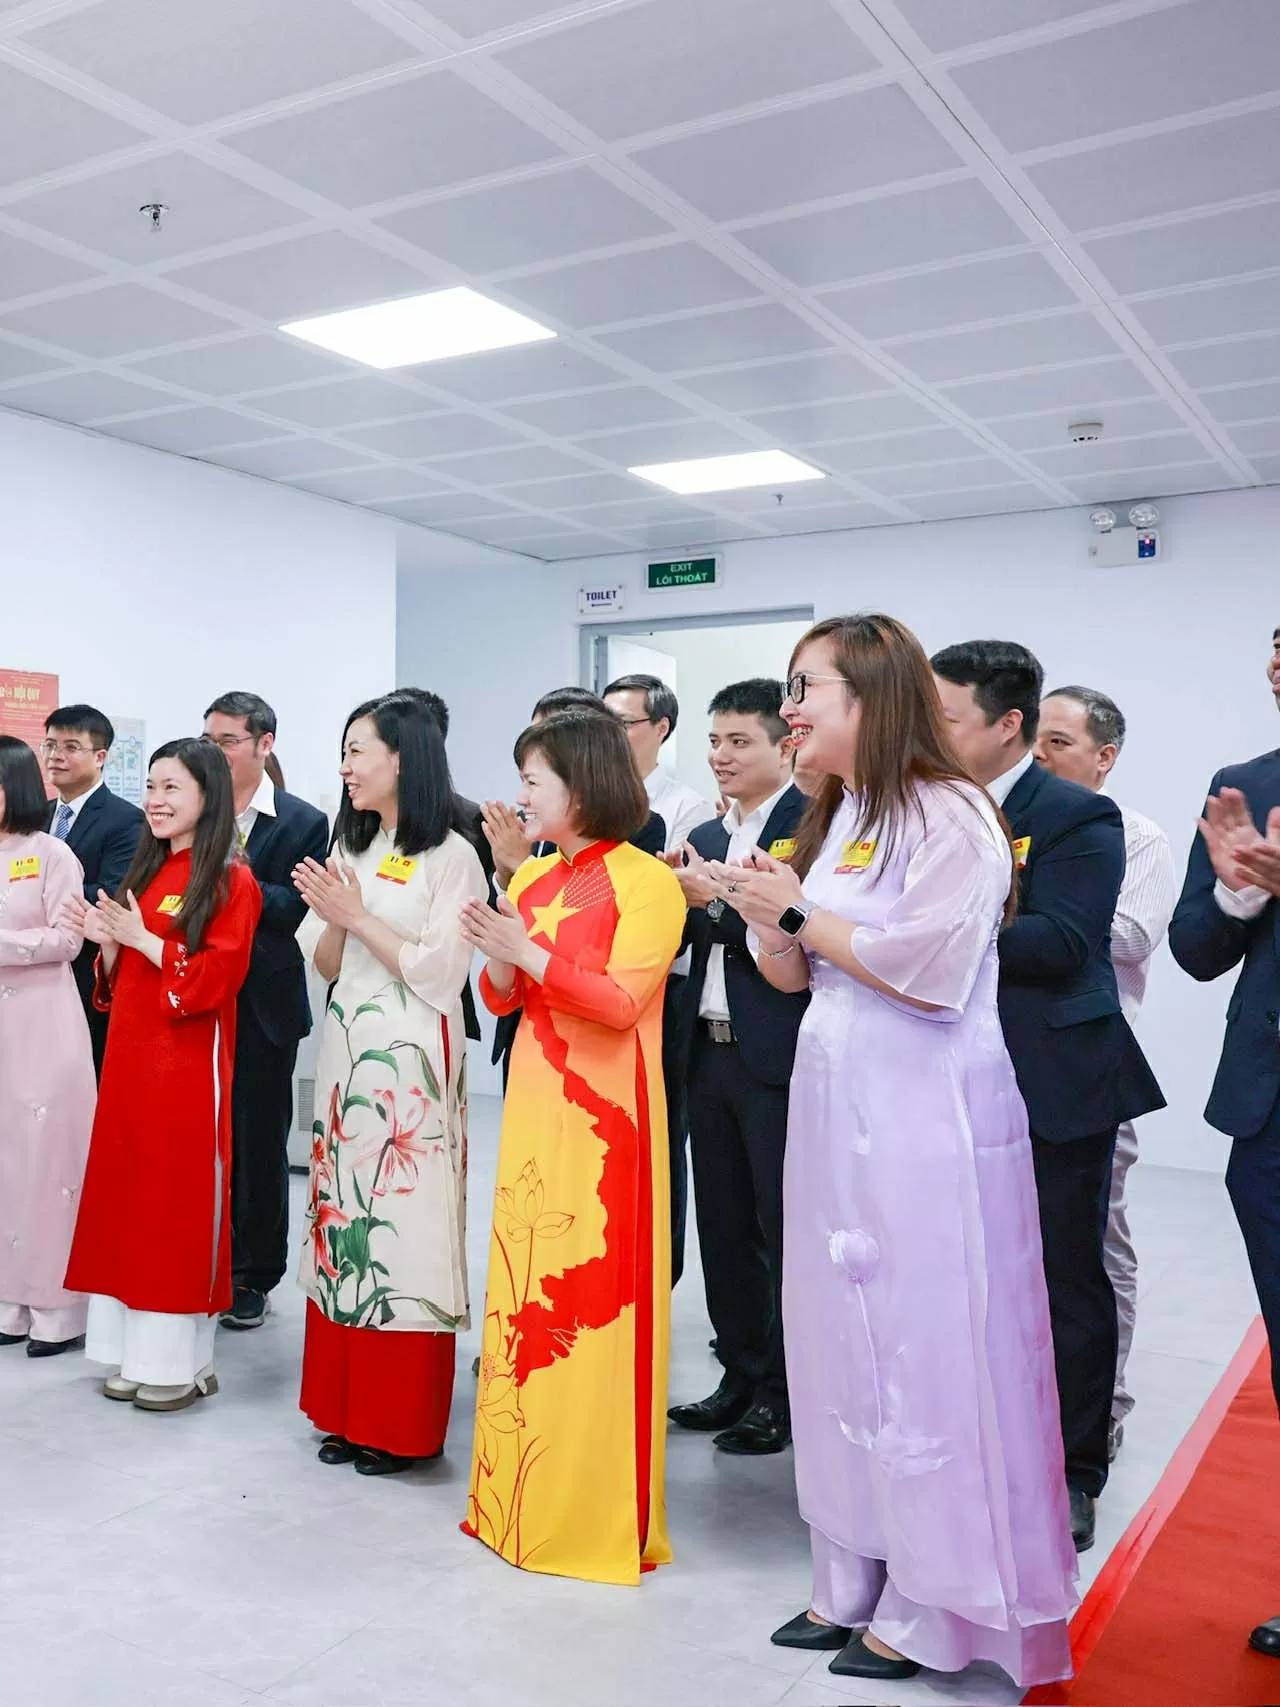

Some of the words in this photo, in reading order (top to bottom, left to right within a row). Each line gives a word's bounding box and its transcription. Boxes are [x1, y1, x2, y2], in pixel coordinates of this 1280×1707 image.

[670, 563, 692, 572] EXIT
[674, 572, 708, 584] THOÁT
[586, 590, 617, 601] TOILET
